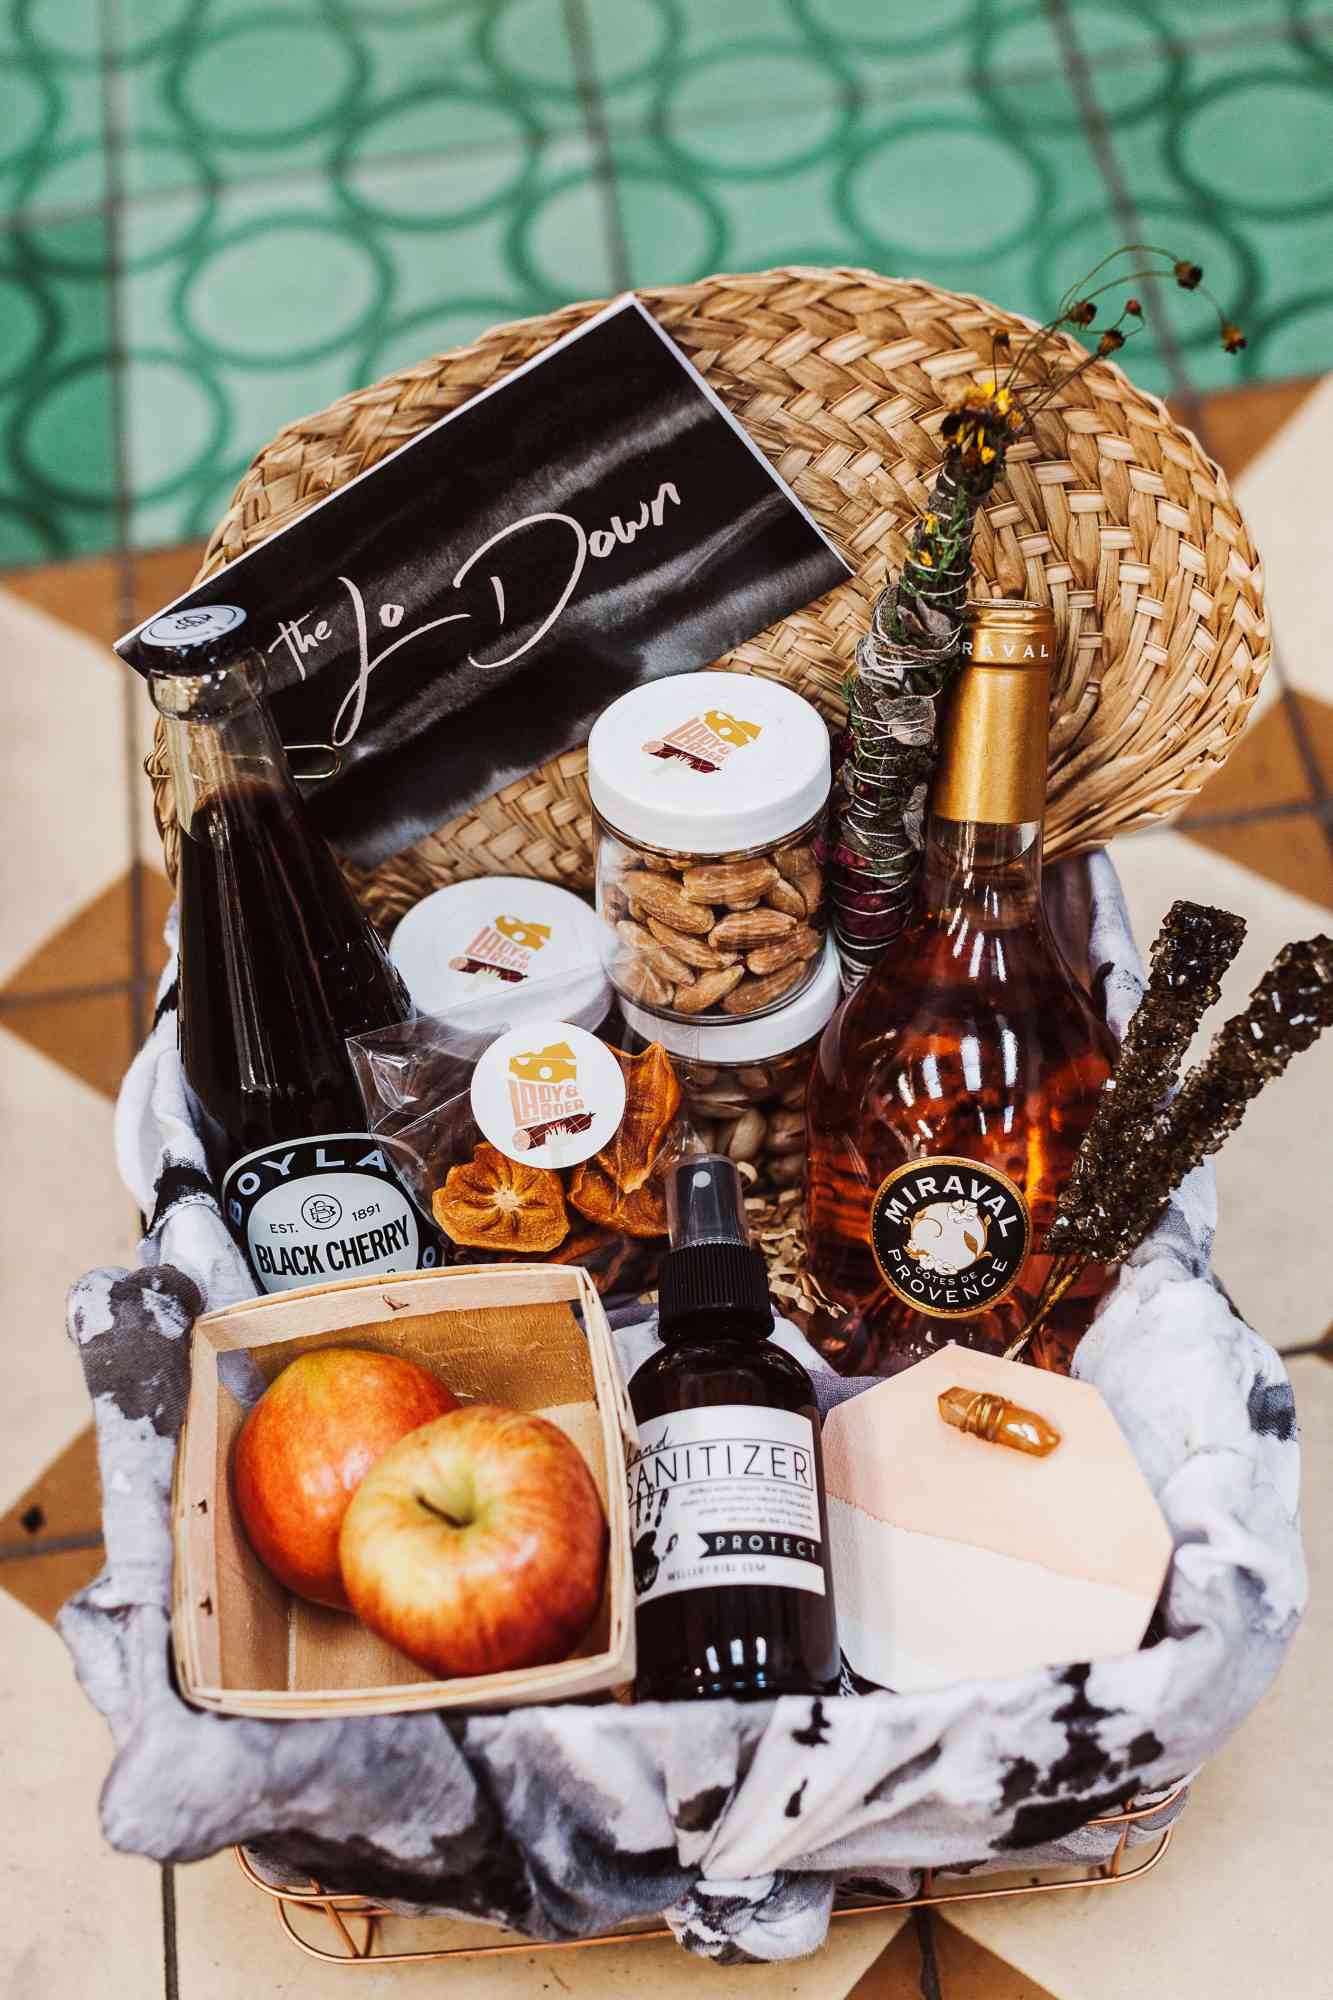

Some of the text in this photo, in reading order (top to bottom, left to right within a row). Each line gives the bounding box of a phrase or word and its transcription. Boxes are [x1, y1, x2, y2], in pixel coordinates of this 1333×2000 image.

[267, 482, 681, 747] the Lo Down
[961, 641, 1050, 659] RAVAL
[229, 1148, 388, 1228] BOYLA
[884, 1175, 1019, 1238] MIRAVAL
[254, 1214, 410, 1277] BLACK CHERRY
[269, 1222, 299, 1234] EST.
[351, 1202, 381, 1222] 1891
[887, 1249, 1008, 1303] PROVENCE
[961, 1271, 978, 1283] DE
[626, 1443, 808, 1504] SANITIZER
[714, 1535, 817, 1558] PROTECT
